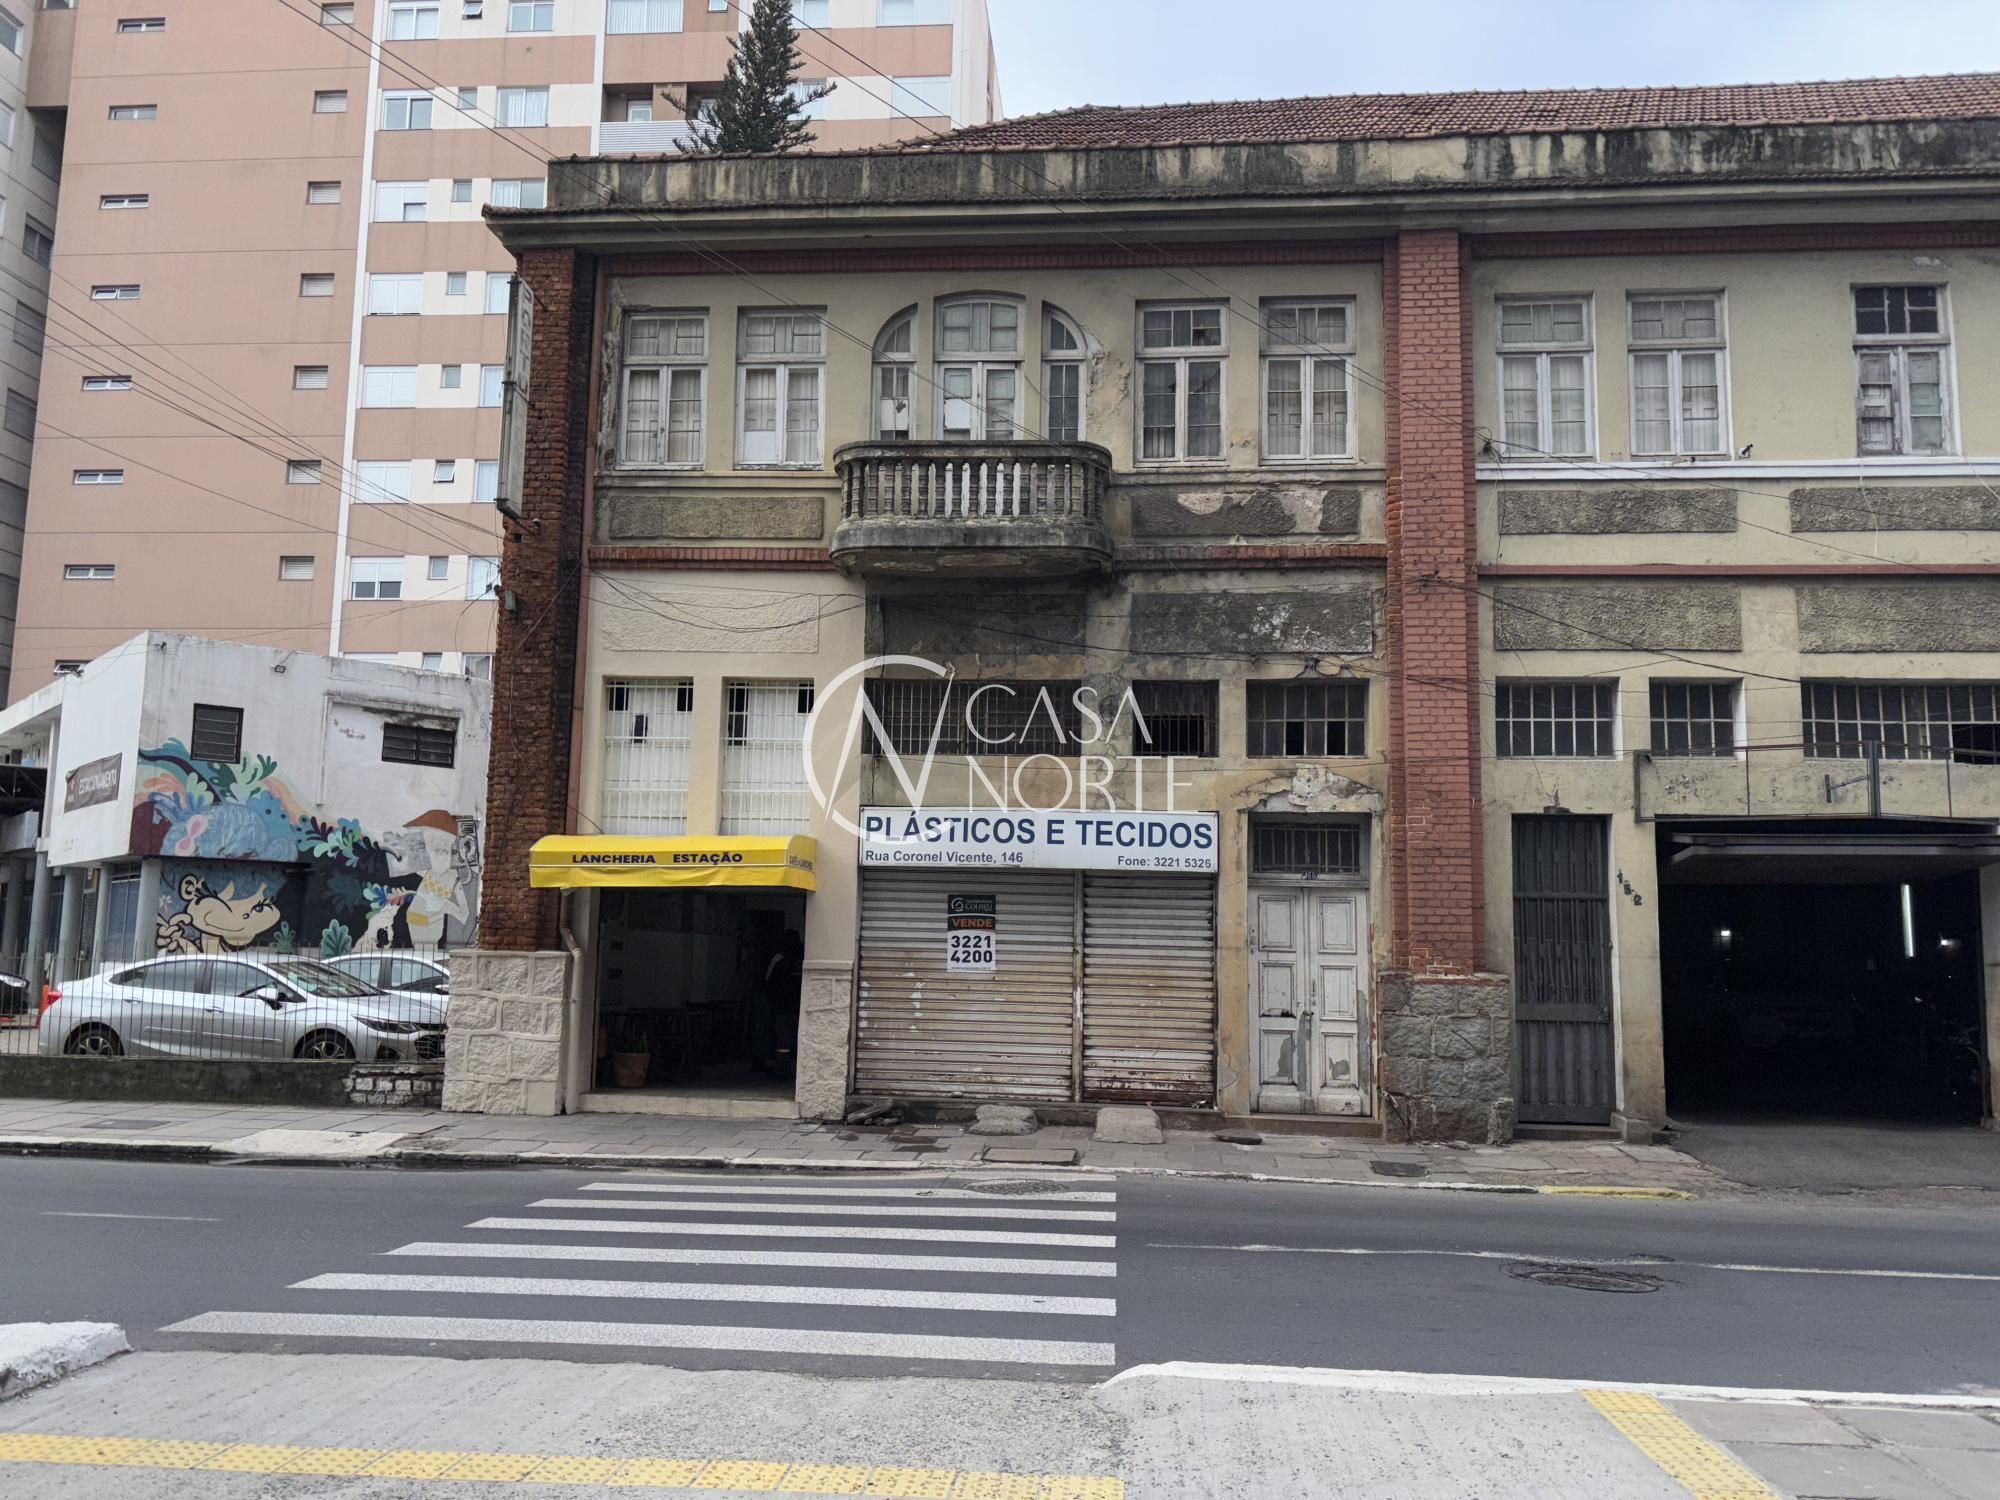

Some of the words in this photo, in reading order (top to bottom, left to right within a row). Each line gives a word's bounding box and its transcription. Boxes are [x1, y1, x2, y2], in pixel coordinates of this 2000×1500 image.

[865, 811, 1036, 845] PLÁSTICOS
[1047, 819, 1065, 845] E
[1075, 820, 1213, 849] TECIDOS
[572, 854, 656, 864] LANCHERIA
[673, 852, 743, 865] ESTAÇÃO
[865, 850, 889, 862] Rua
[893, 850, 942, 863] Coronel
[946, 851, 997, 864] Vicente,
[1002, 852, 1023, 863] 146
[1117, 856, 1150, 867] Fone:
[1154, 857, 1180, 868] 3221
[1184, 858, 1212, 869] 5326
[951, 918, 993, 928] VENDE
[951, 935, 991, 949] 3221
[950, 950, 993, 964] 4200
